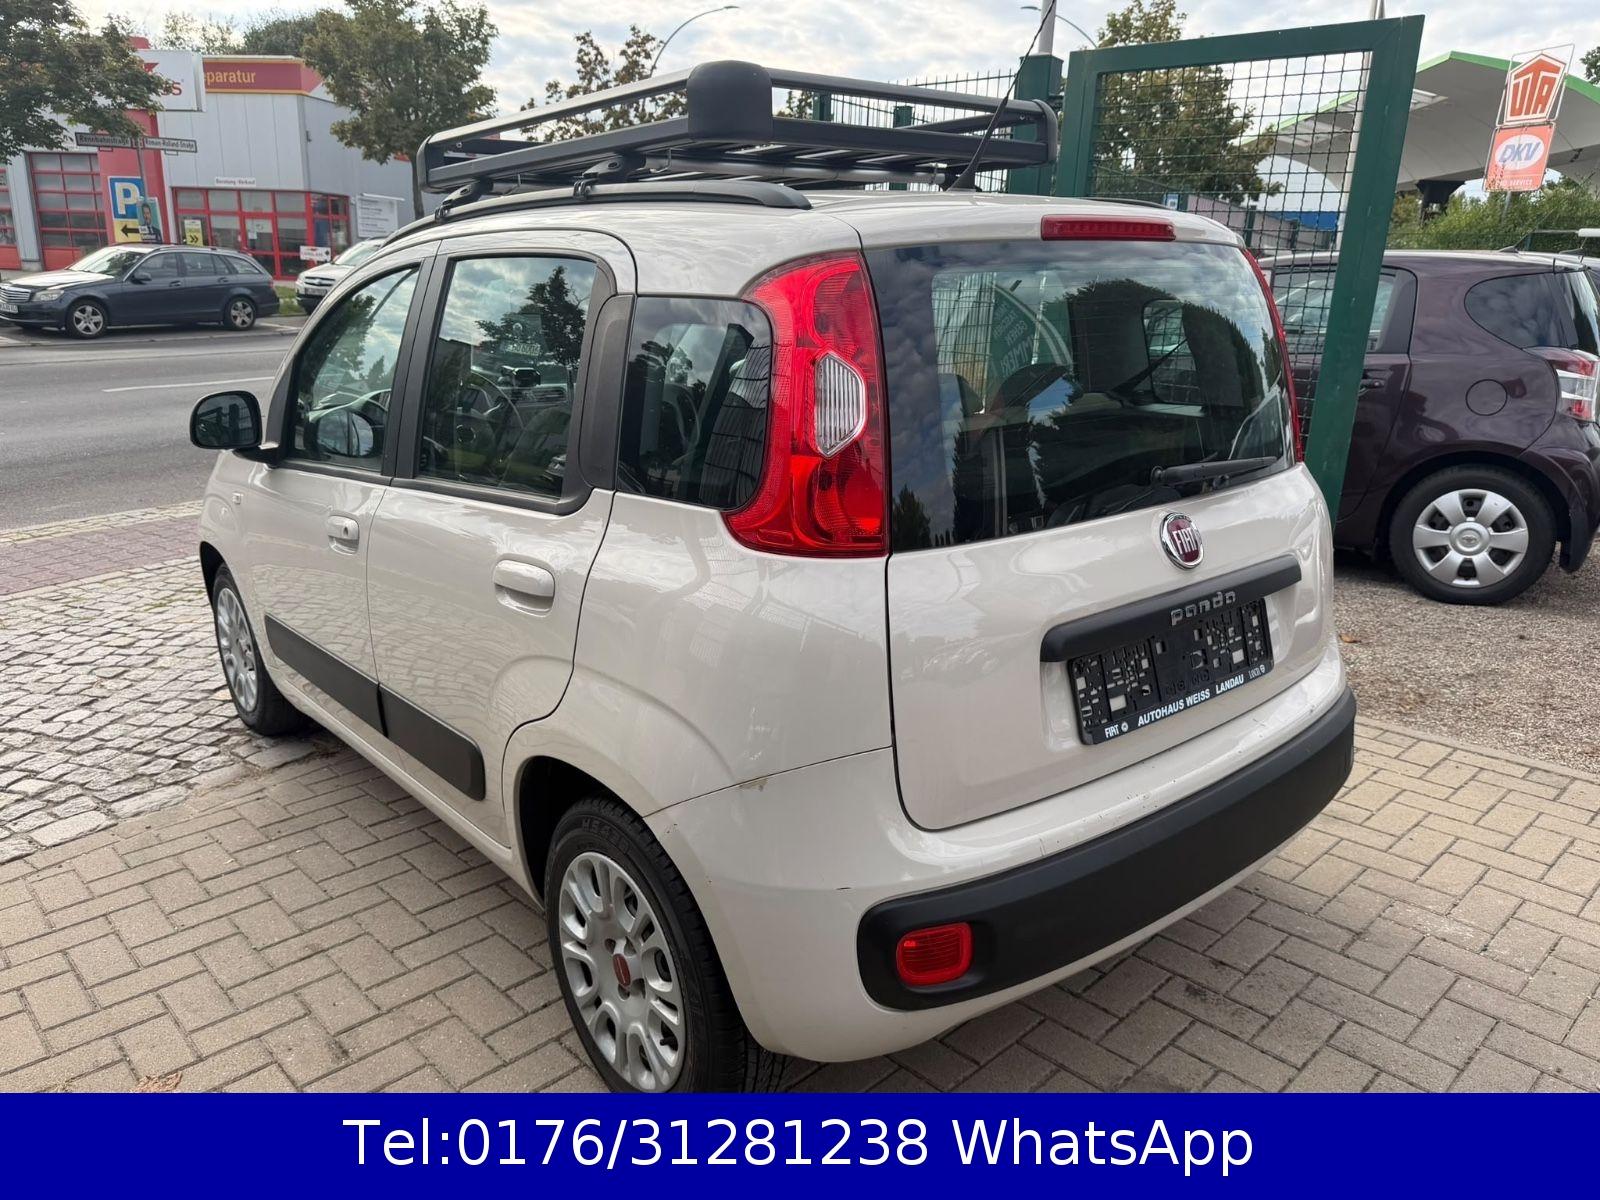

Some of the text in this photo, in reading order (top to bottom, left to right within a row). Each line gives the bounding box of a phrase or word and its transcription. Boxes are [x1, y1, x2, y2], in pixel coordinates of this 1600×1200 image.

[204, 70, 256, 85] paratur
[1510, 58, 1561, 117] UTA
[1499, 142, 1541, 163] DKV
[115, 182, 140, 214] P
[1172, 527, 1198, 554] FIAT
[1171, 591, 1236, 626] panda
[1104, 674, 1244, 739] FIAT AUTOHAUS WEISS LANDAU
